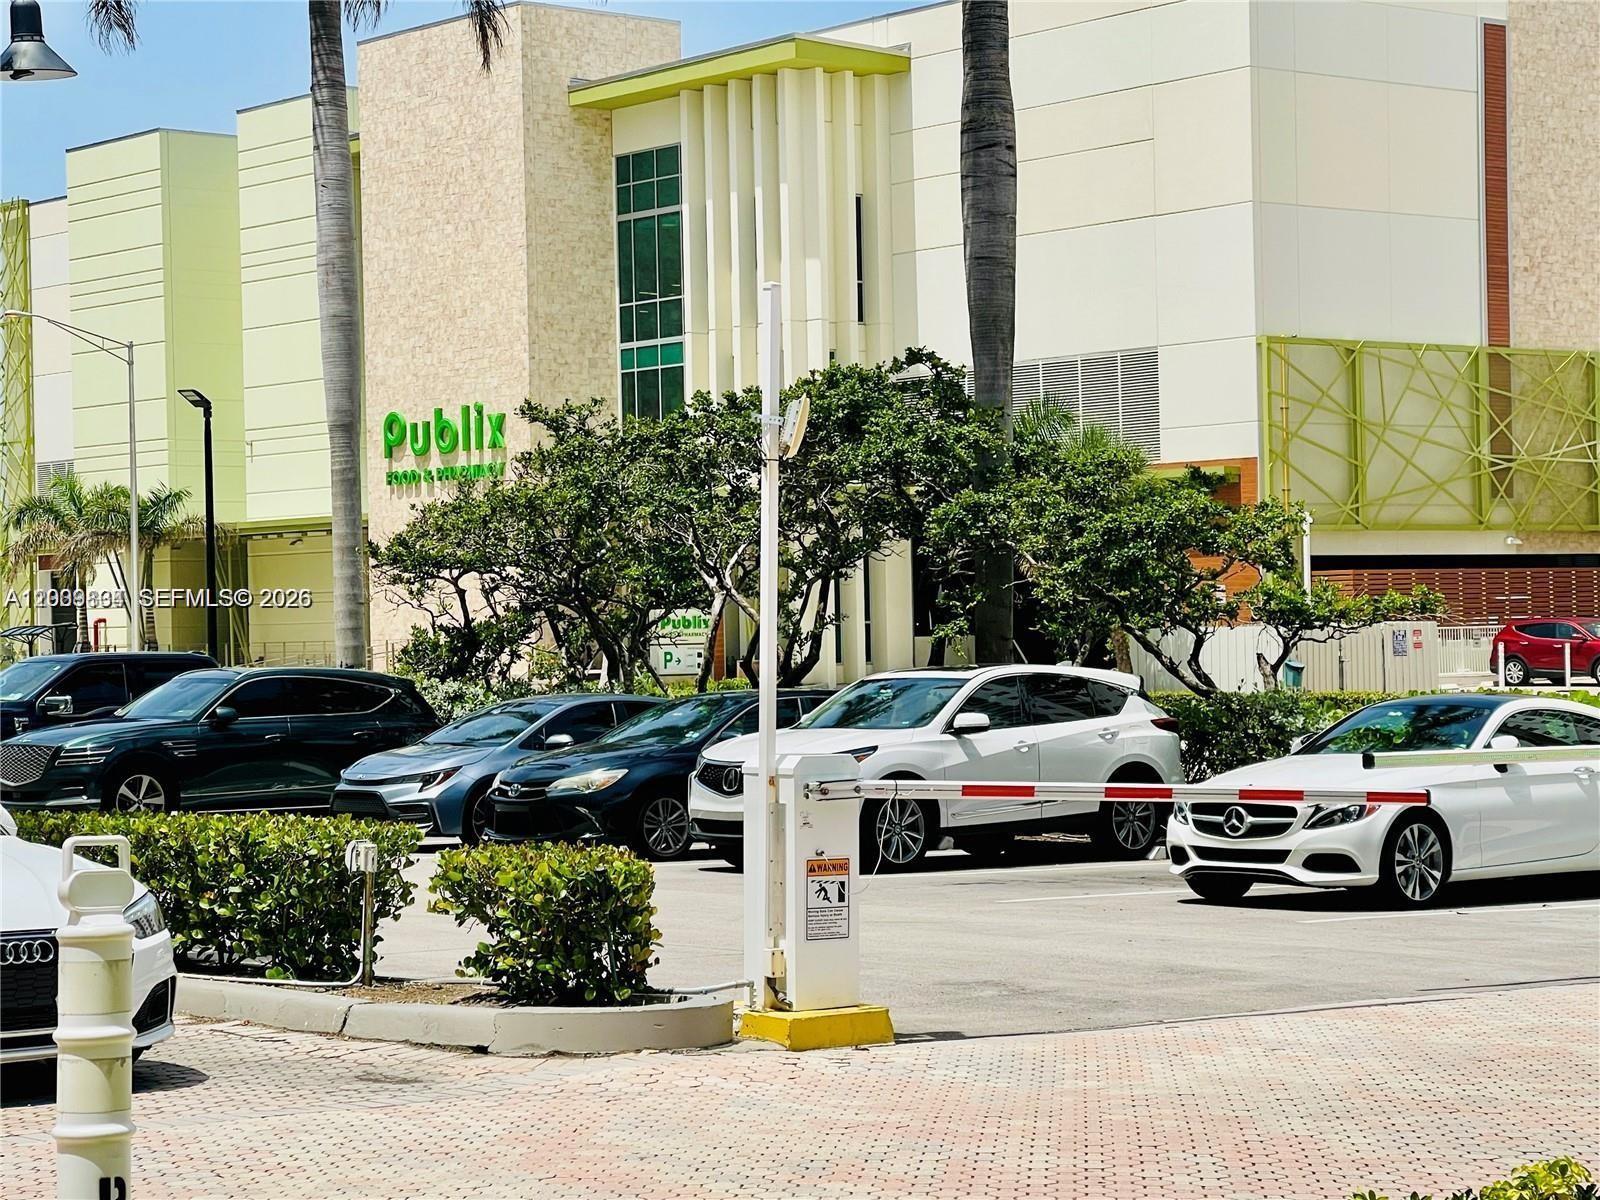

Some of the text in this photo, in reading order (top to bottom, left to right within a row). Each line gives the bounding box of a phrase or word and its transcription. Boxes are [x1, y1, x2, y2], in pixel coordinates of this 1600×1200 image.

[383, 401, 507, 459] Publix
[385, 469, 421, 486] FOOD
[422, 467, 435, 483] &
[661, 615, 710, 630] Publix
[663, 651, 673, 670] P
[817, 862, 848, 872] WARNING
